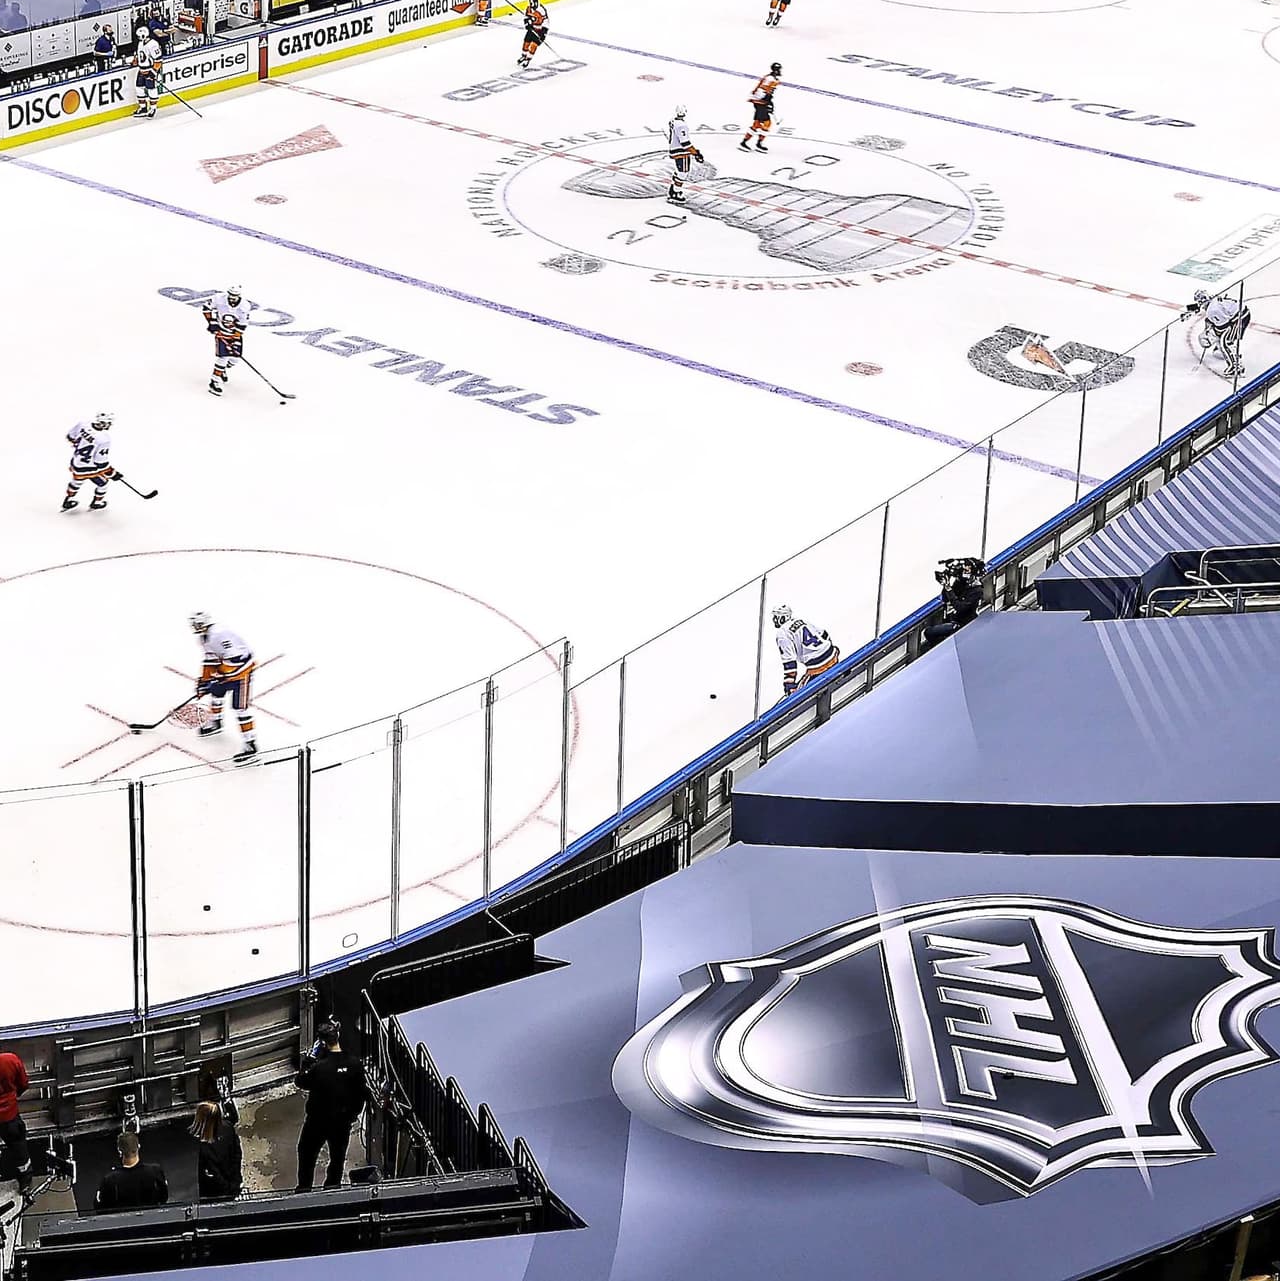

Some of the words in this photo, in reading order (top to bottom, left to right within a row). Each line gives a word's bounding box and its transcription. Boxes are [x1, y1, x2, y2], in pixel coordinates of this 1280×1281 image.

[278, 16, 374, 57] GATORADE
[160, 52, 246, 85] nterprise
[442, 57, 588, 104] GEICO
[827, 53, 1080, 104] STANLEY
[1070, 102, 1196, 128] CUP
[8, 80, 125, 130] DISCOVER
[210, 130, 334, 176] Budweiser
[770, 154, 842, 182] 20
[466, 171, 524, 239] NATIONAL
[497, 128, 625, 168] HOCKEY
[607, 214, 688, 246] 20
[649, 271, 857, 292] Scotiabank
[873, 256, 954, 284] Arena
[157, 285, 297, 327] CP
[273, 326, 602, 425] STANLEY
[925, 932, 1080, 1101] NHL
